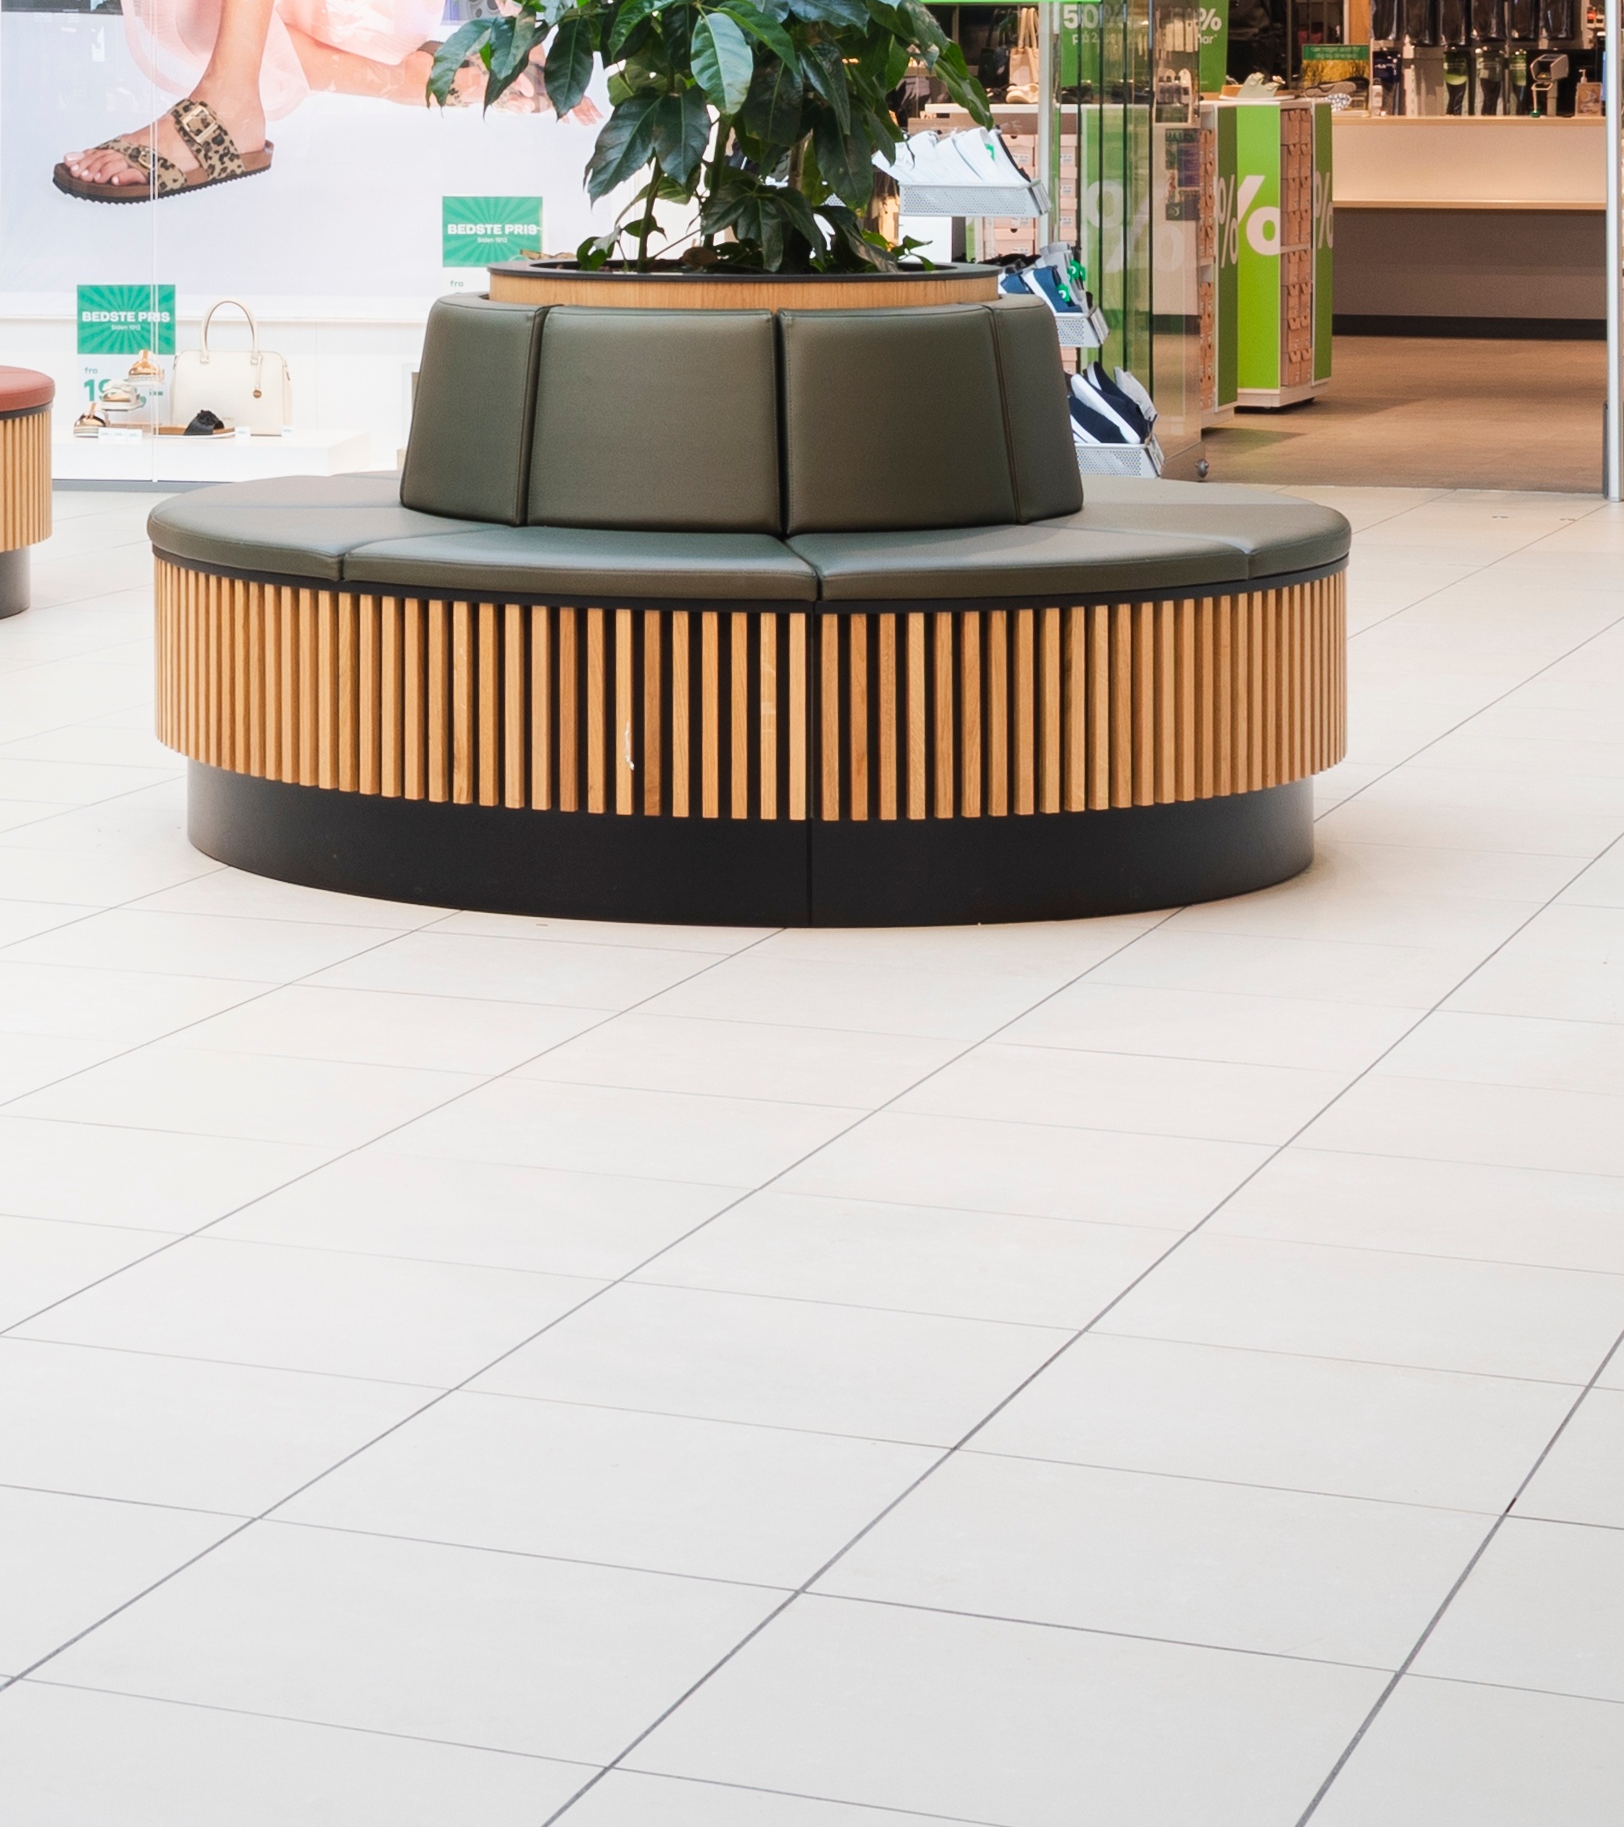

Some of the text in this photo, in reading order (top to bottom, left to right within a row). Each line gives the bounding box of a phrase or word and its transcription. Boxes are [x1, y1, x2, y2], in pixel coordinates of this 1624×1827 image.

[447, 224, 538, 235] BEDSTE PRIS
[82, 311, 171, 323] BEDSTE PRIS
